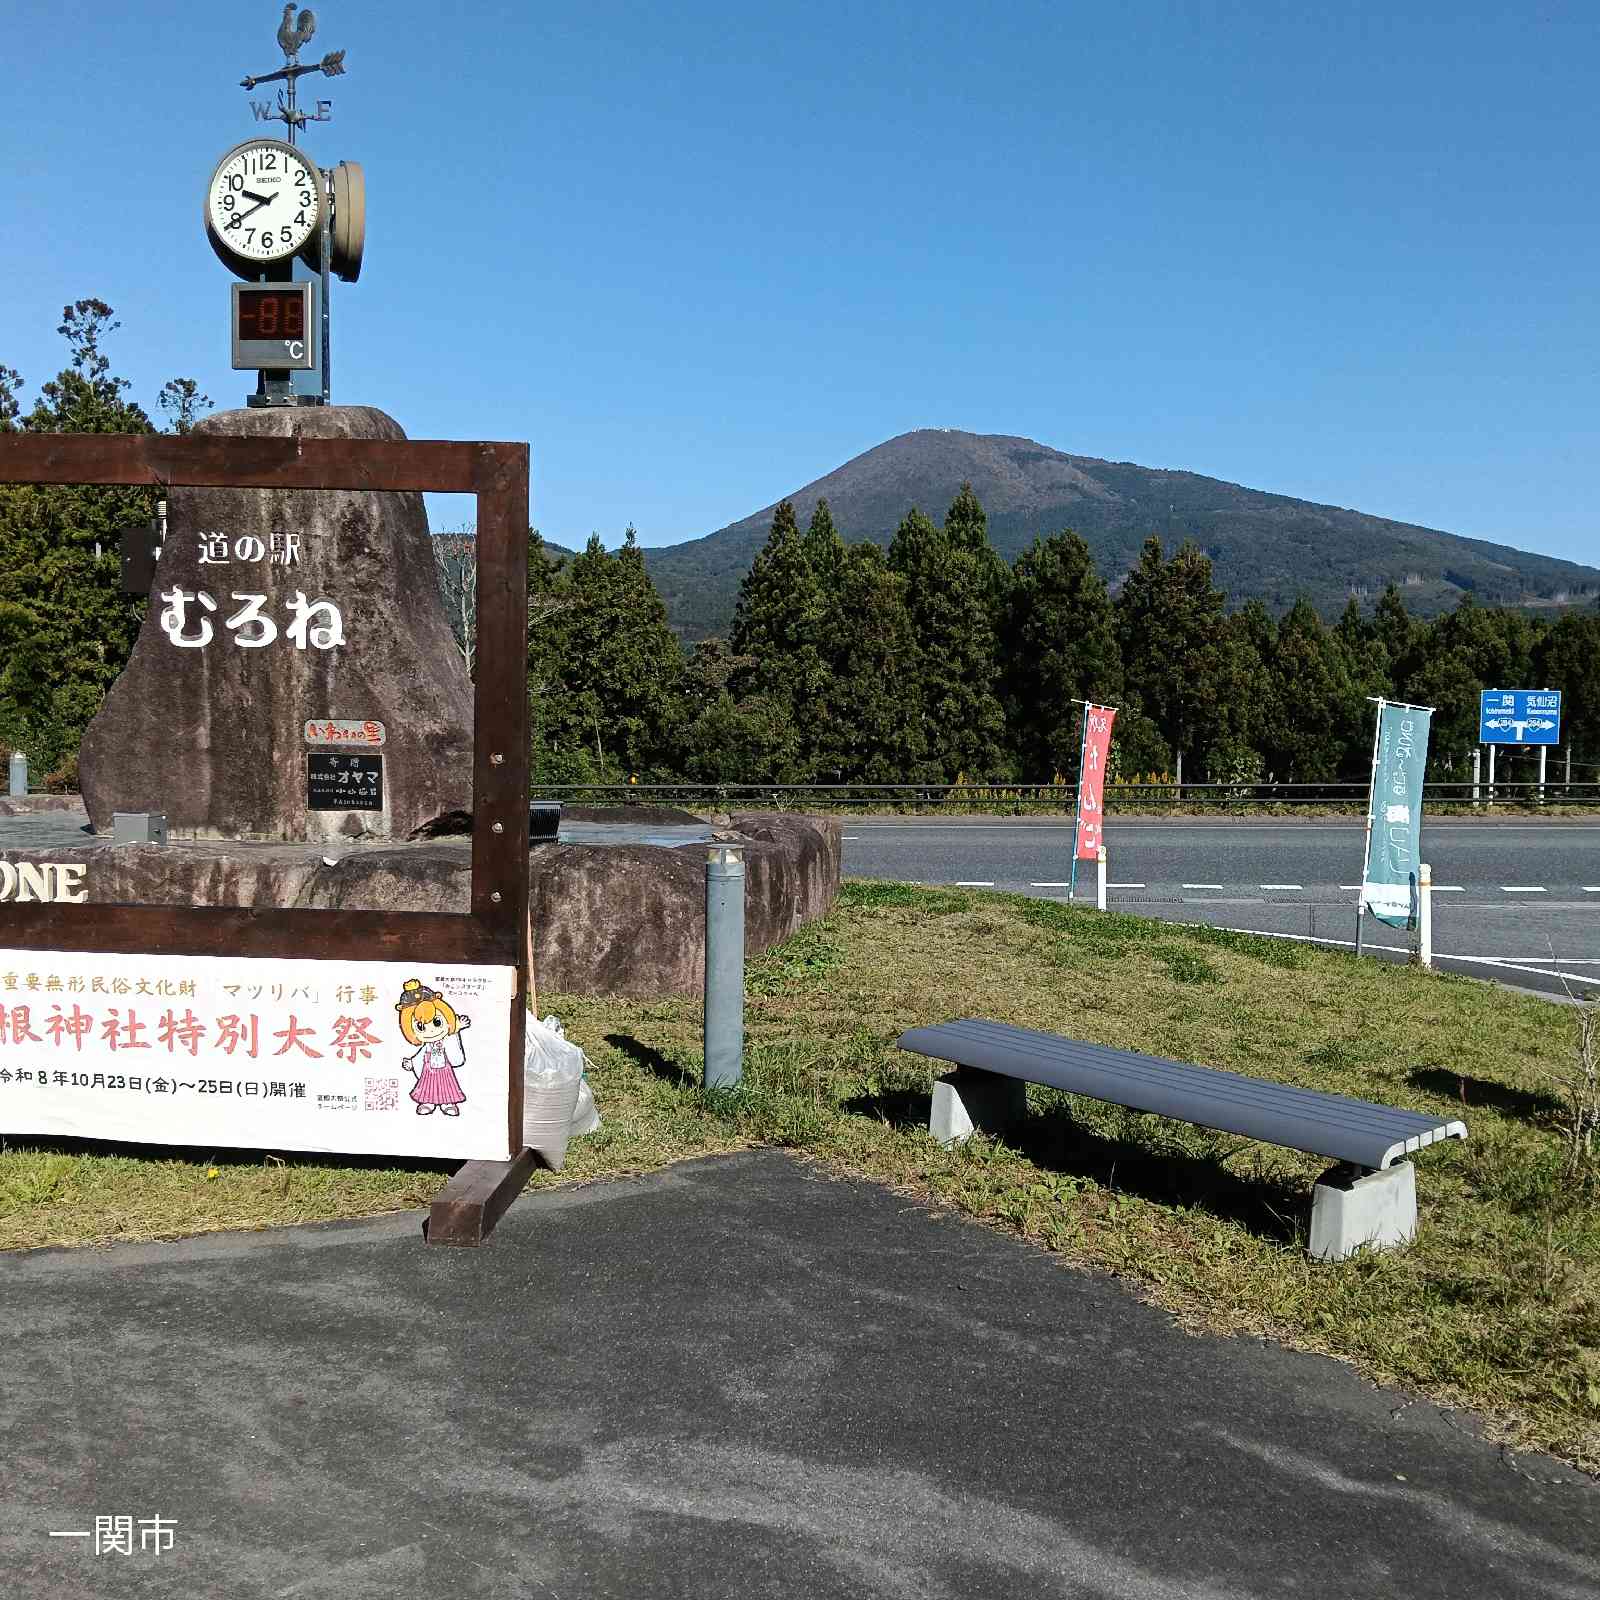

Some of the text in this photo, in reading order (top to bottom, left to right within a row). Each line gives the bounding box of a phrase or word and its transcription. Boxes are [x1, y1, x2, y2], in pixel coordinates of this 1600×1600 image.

[250, 101, 272, 121] W
[317, 100, 332, 121] E
[244, 158, 256, 175] 11
[260, 153, 277, 170] 12
[228, 173, 244, 191] 10
[256, 176, 282, 184] SEIKO
[294, 169, 306, 187] 2
[223, 194, 235, 211] 9
[299, 190, 311, 207] 3
[230, 212, 242, 229] 8
[293, 210, 307, 227] 4
[245, 227, 256, 244] 7
[261, 231, 273, 249] 6
[280, 225, 292, 243] 5
[198, 531, 301, 564] 道の駅
[160, 584, 347, 650] むろね
[1486, 694, 1558, 707] 一関 気仙沼
[1, 971, 198, 998] 重要無形民俗文化財
[0, 1003, 385, 1065] 根神社特別大祭
